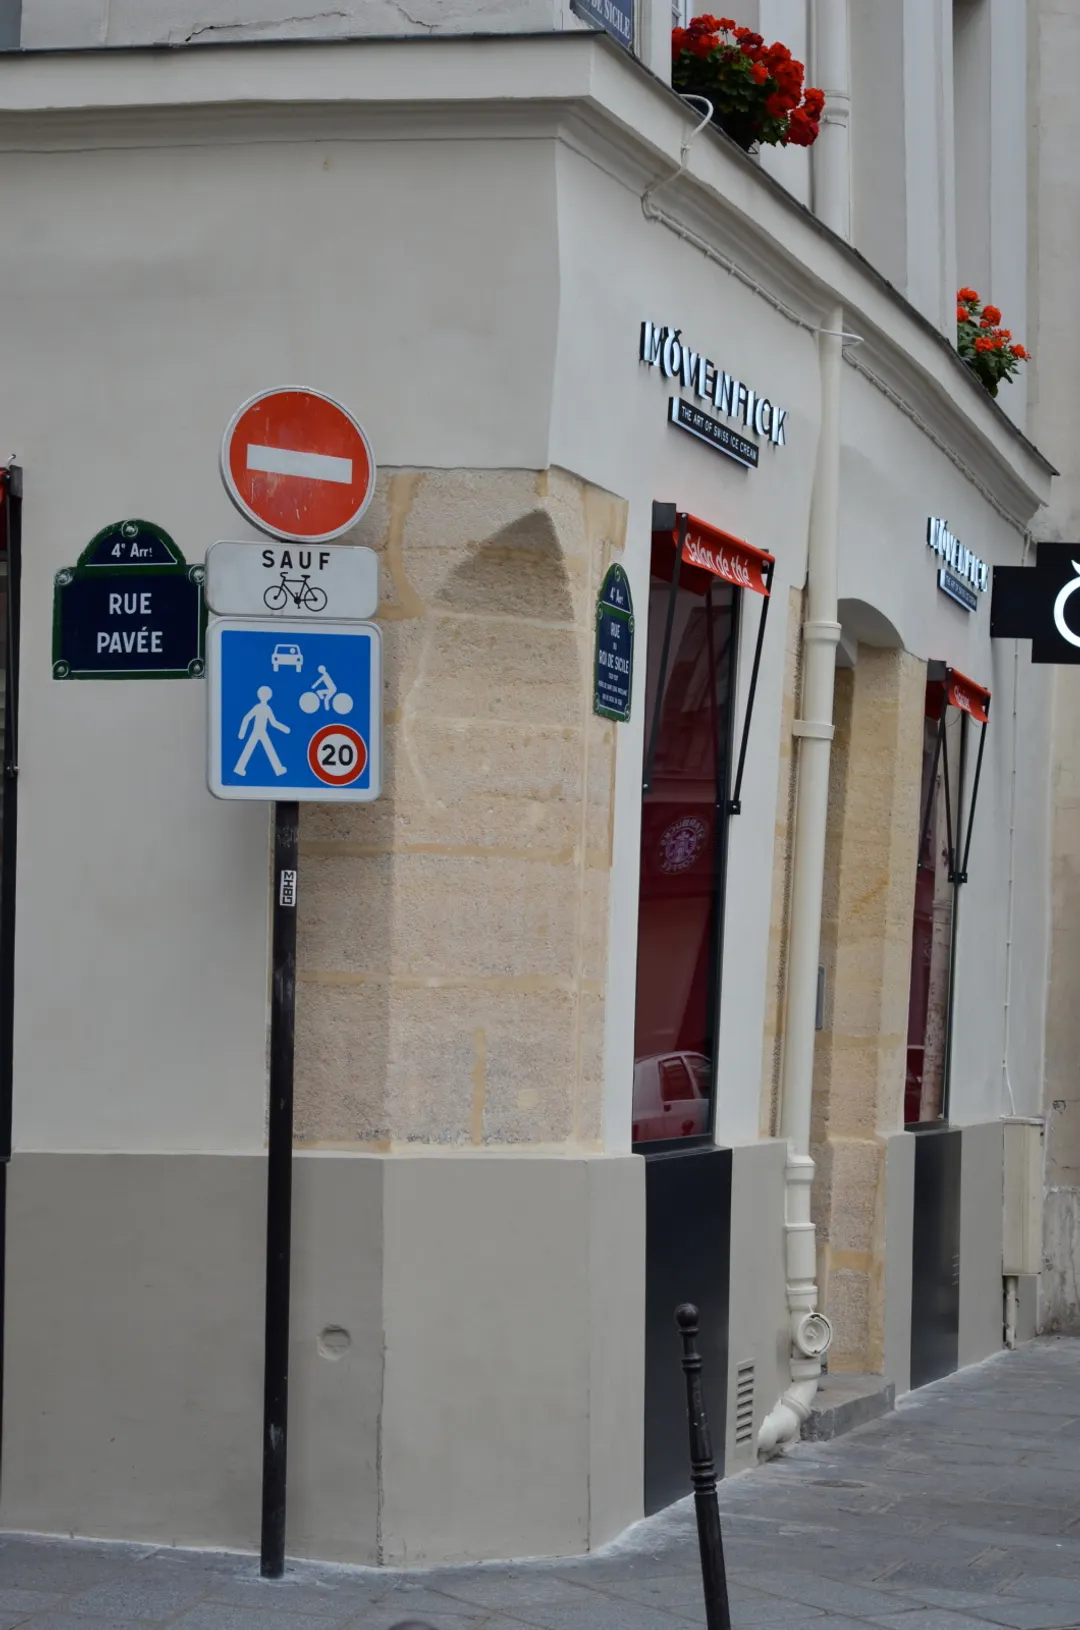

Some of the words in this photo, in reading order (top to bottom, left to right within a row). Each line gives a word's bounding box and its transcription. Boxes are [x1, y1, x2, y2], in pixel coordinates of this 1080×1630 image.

[604, 0, 630, 39] SICILE
[640, 320, 787, 445] MÖVENPICK
[681, 405, 692, 421] THE
[693, 414, 704, 428] ART
[704, 420, 712, 432] OF
[713, 425, 729, 443] SWISS
[730, 435, 739, 450] ICE
[739, 441, 757, 461] CREAM
[262, 550, 331, 571] SAUF
[684, 532, 719, 573] Salon
[715, 547, 733, 579] de
[730, 555, 753, 588] thé
[109, 593, 152, 614] RUE
[96, 626, 163, 653] PAVÉE
[611, 622, 620, 639] RUE
[607, 652, 614, 669] DE
[614, 655, 629, 675] SICILE
[321, 744, 354, 766] 20
